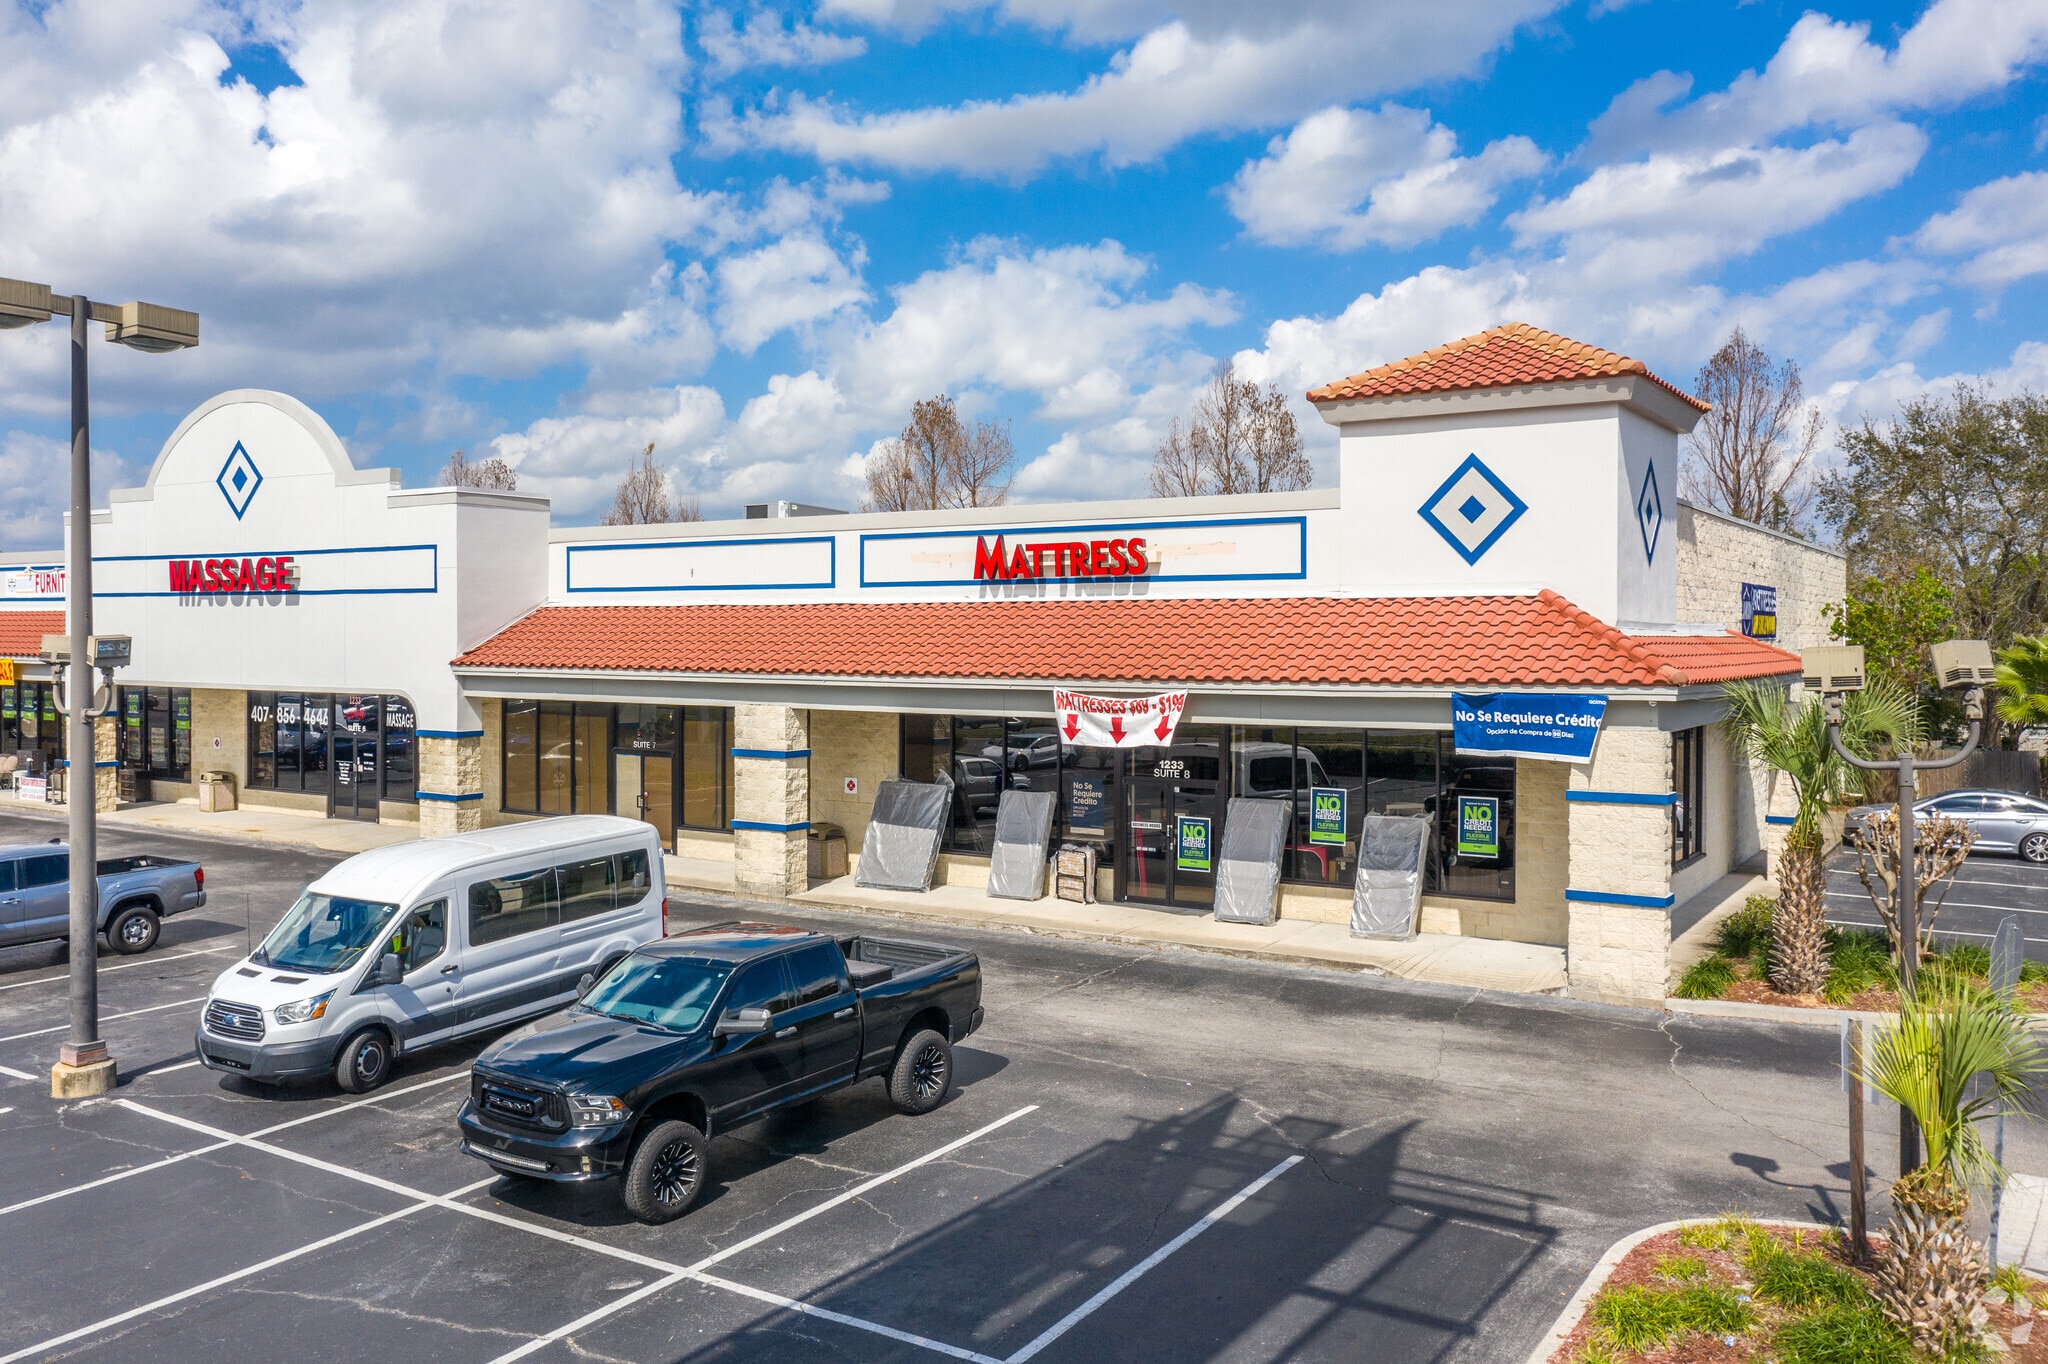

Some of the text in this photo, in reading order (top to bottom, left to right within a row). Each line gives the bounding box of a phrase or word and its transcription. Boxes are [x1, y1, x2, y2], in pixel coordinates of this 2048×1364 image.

[974, 534, 1148, 580] MATTRESS
[169, 557, 294, 592] MASSAGE
[35, 573, 66, 593] FURNIT
[1056, 690, 1128, 714] MATTRESSES
[303, 708, 329, 726] 4646
[386, 712, 414, 728] MASSAGE
[1455, 710, 1475, 722] No
[1477, 711, 1492, 722] Se
[1494, 711, 1553, 725] Requiere
[633, 740, 656, 749] SUITE 7
[1159, 760, 1184, 770] 1233
[1153, 768, 1190, 779] SUITE 8
[1073, 782, 1093, 790] No Se
[1073, 789, 1103, 799] Requiere
[1315, 796, 1341, 810] NO
[1464, 806, 1492, 821] NO
[1463, 824, 1492, 832] NEEDED
[1464, 818, 1492, 827] CREDIT
[1183, 824, 1206, 838] NO
[1182, 841, 1206, 849] NEEDED
